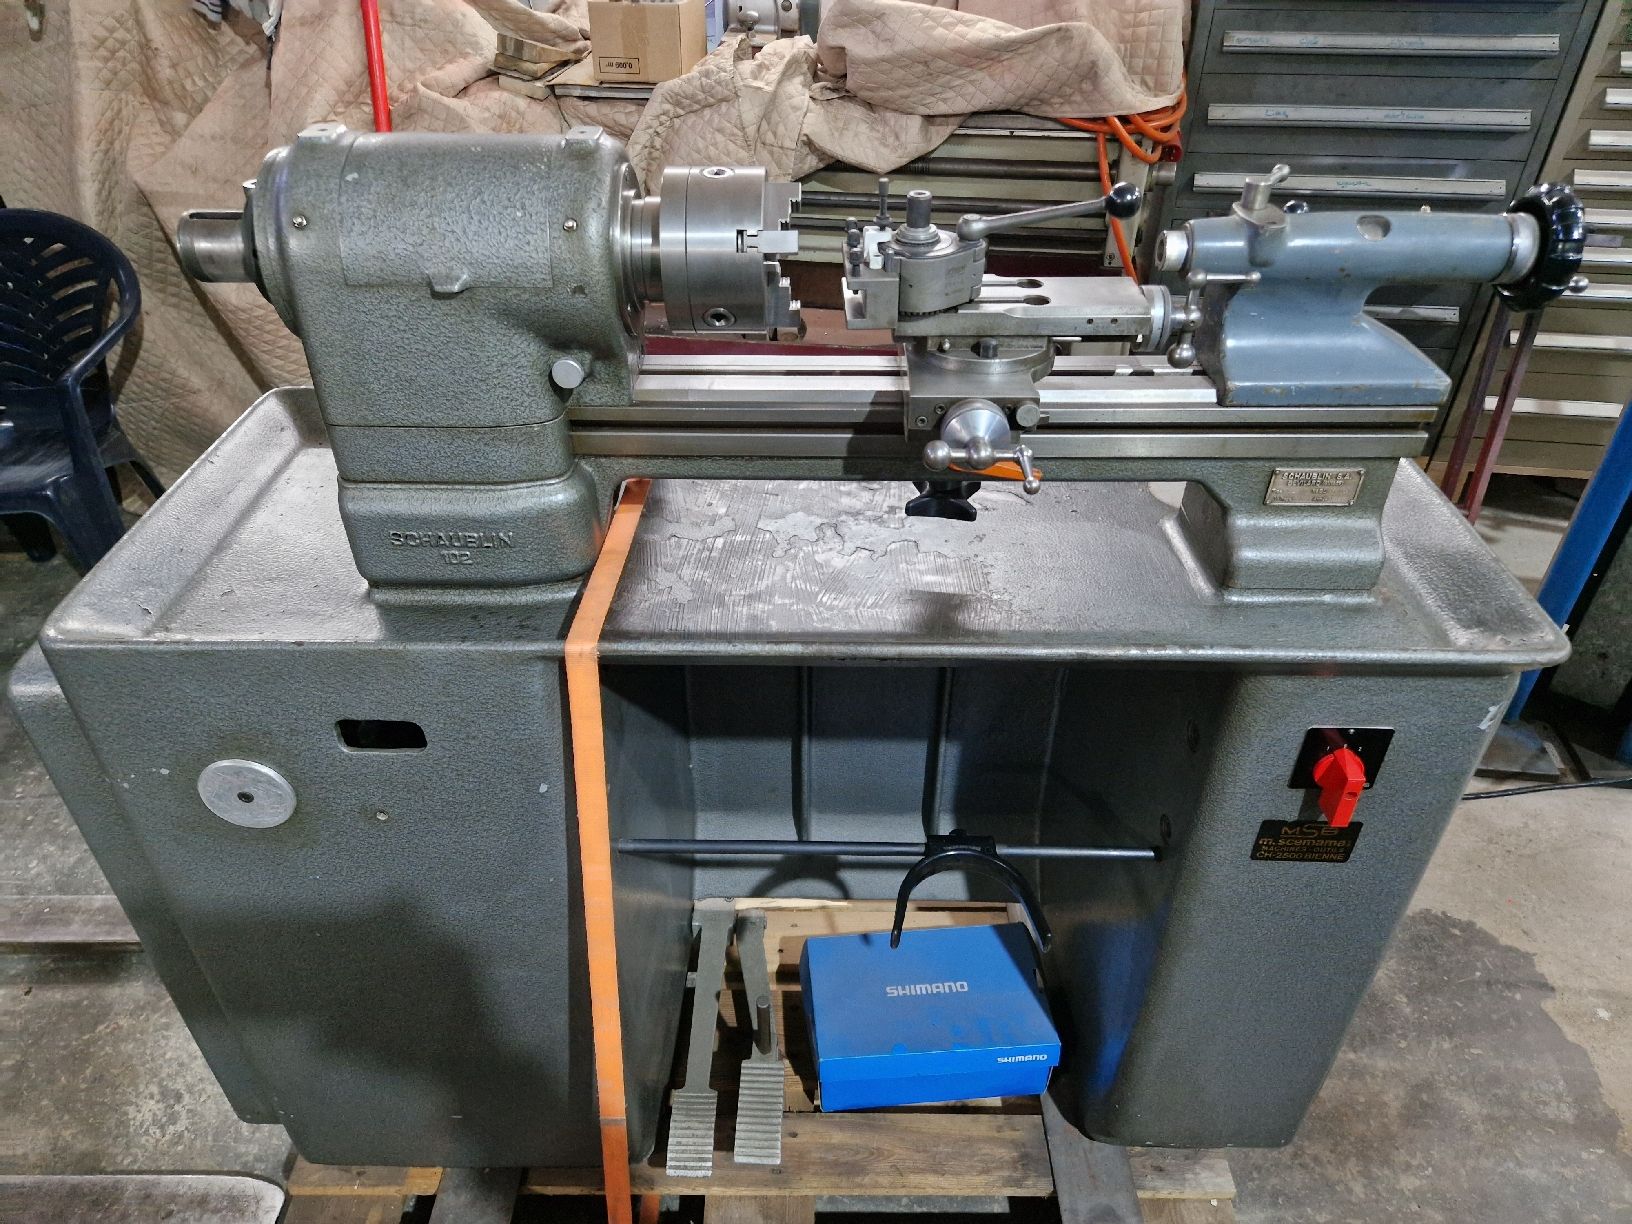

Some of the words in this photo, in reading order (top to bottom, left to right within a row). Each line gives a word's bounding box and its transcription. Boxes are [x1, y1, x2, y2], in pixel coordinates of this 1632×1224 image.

[1282, 472, 1331, 480] SCHAUBLIN
[389, 531, 513, 548] SCHAUBLIN
[440, 550, 473, 565] 102
[886, 981, 969, 997] SHIMANO
[997, 1054, 1048, 1063] SHIMANO
